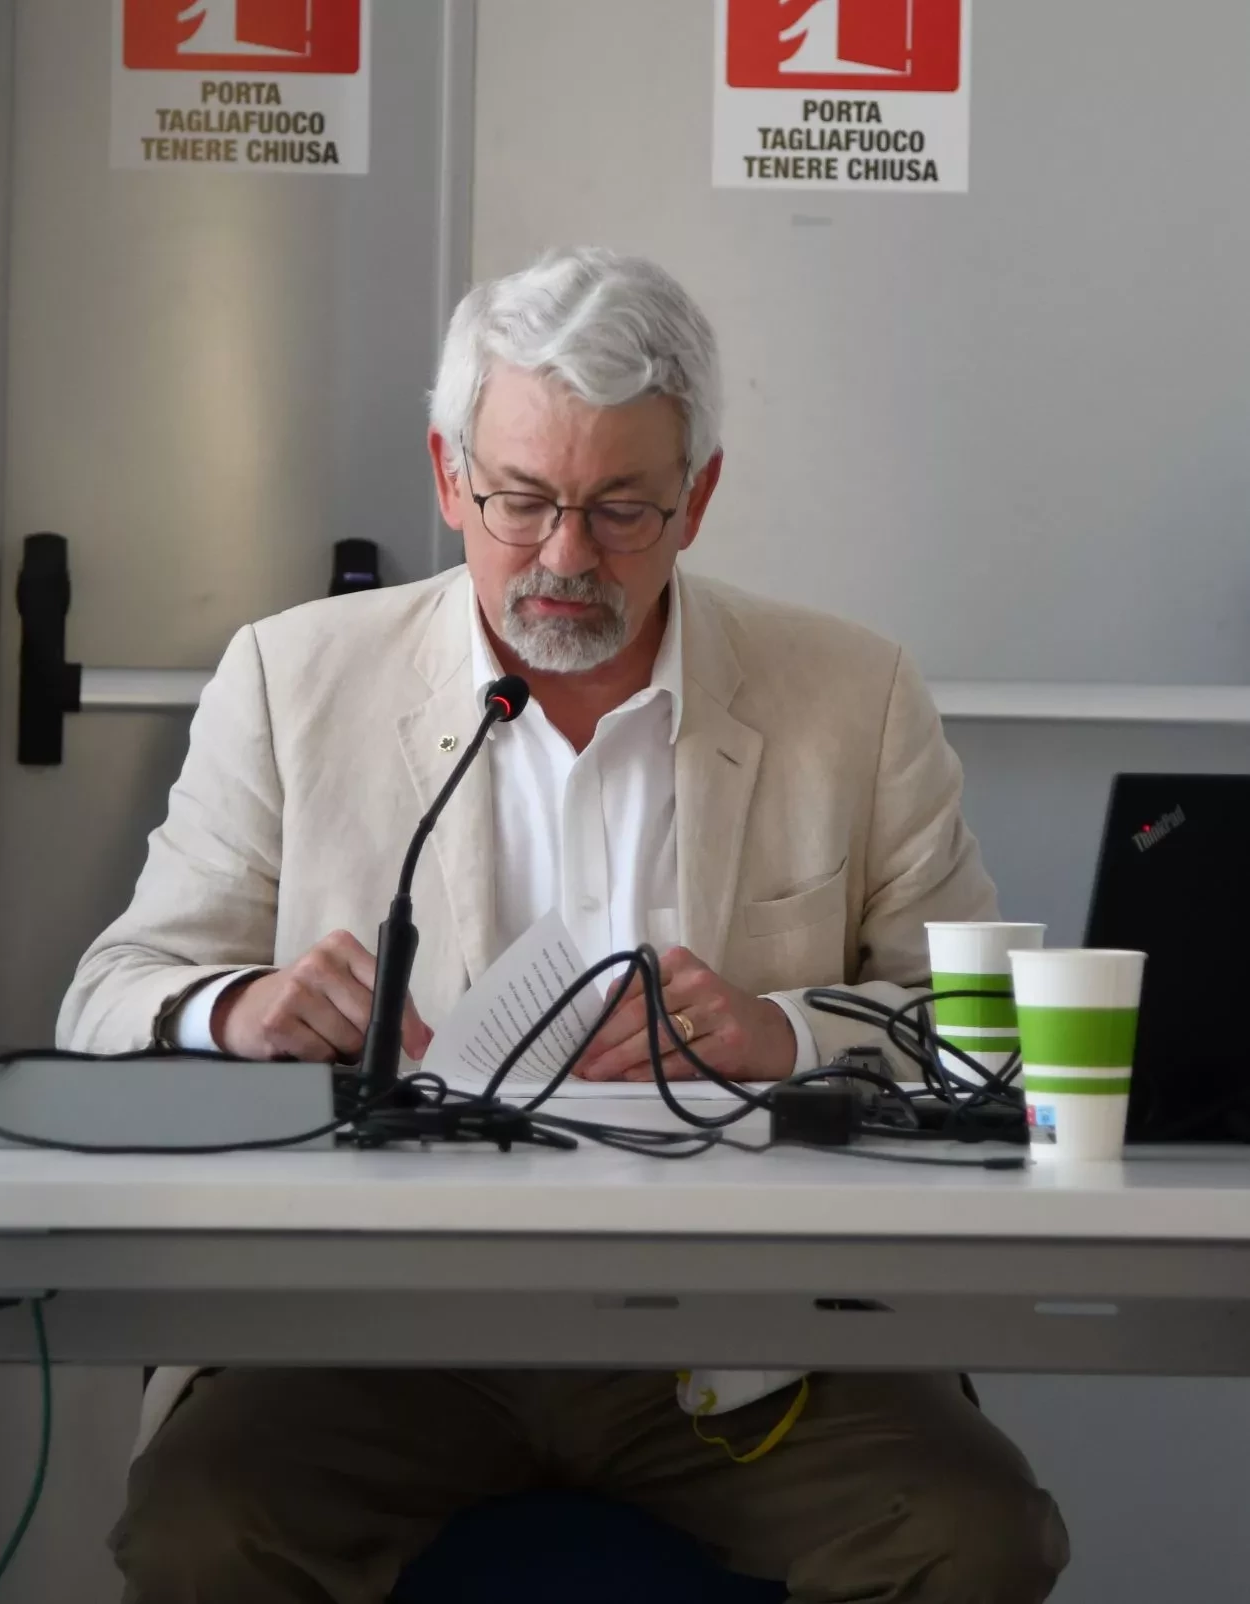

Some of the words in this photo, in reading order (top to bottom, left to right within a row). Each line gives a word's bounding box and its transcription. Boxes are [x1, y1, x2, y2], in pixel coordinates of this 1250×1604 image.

[201, 80, 282, 105] PORTA
[156, 109, 325, 135] TAGLIAFUOCO
[802, 99, 882, 123] PORTA
[141, 137, 238, 162] TENERE
[246, 139, 339, 164] CHIUSA
[758, 127, 925, 153] TAGLIAFUOCO
[743, 155, 838, 180] TENERE
[847, 158, 938, 182] CHIUSA
[1131, 803, 1186, 853] ThinkPad
